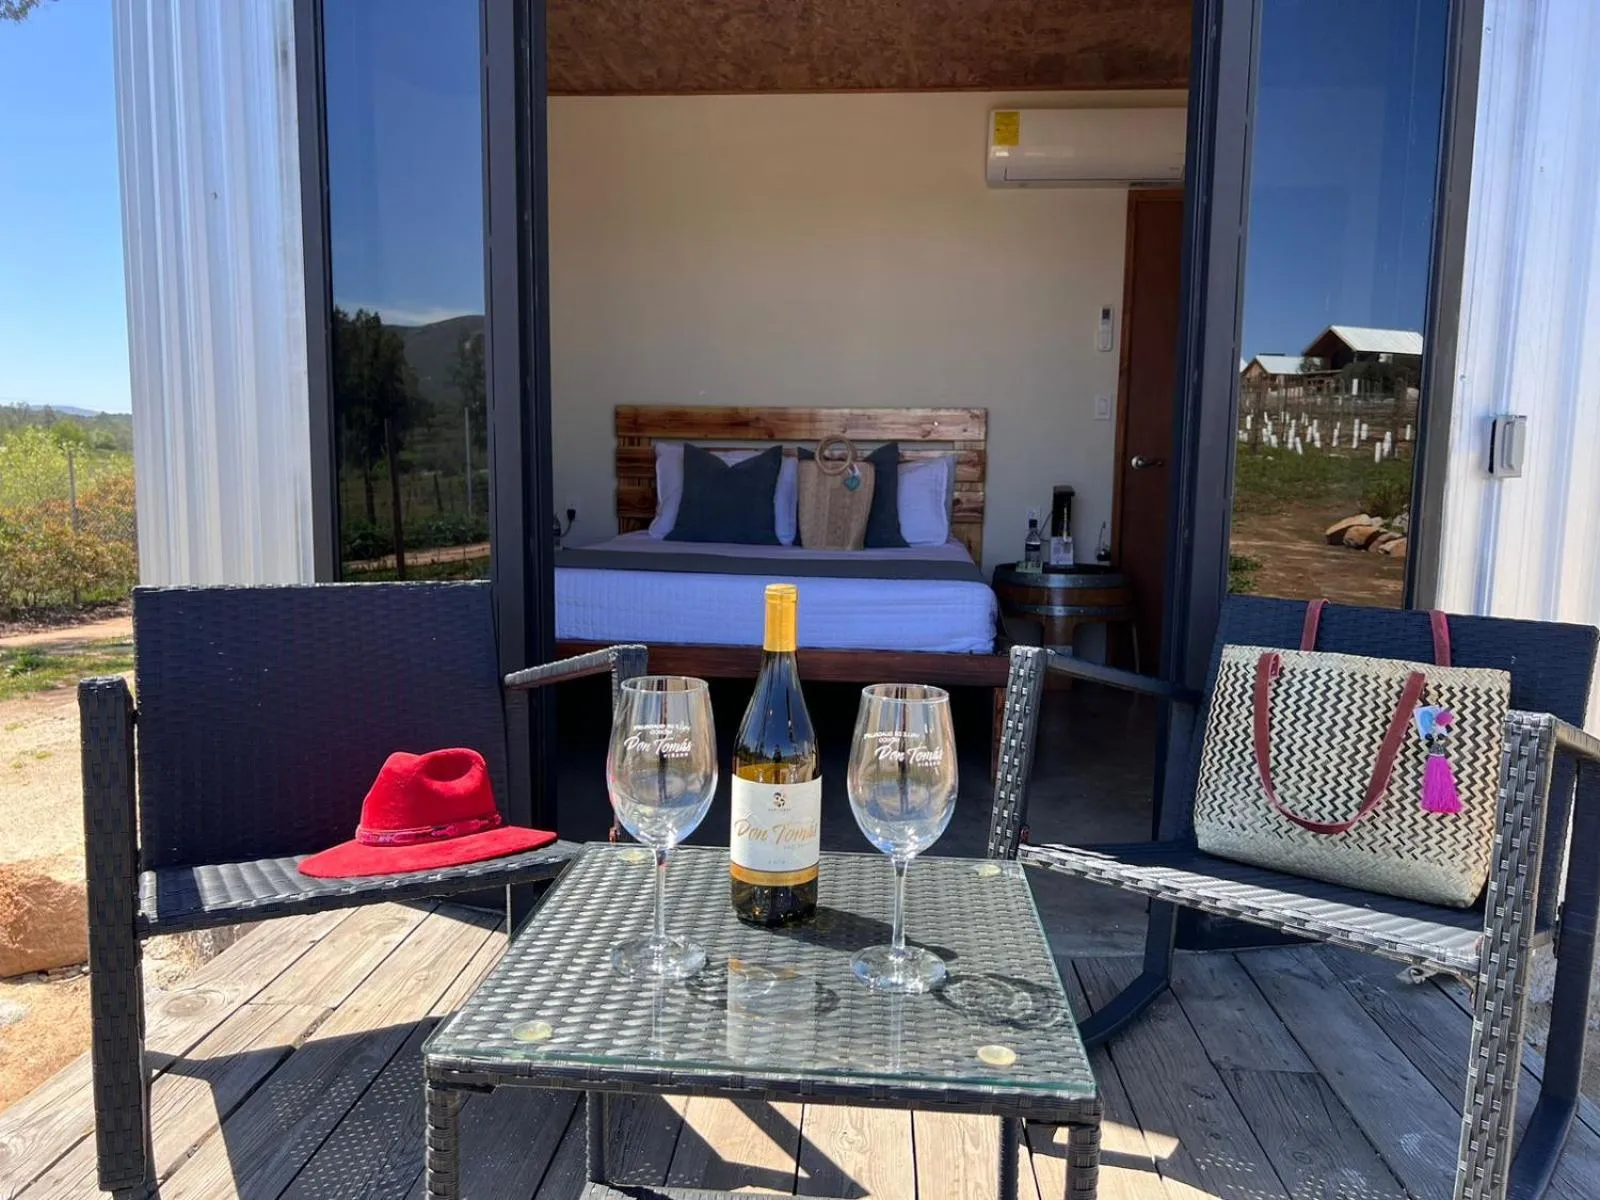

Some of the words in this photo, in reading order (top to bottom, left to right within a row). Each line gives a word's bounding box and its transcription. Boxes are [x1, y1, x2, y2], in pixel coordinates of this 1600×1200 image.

[623, 731, 652, 753] Don
[653, 730, 692, 755] Tomás
[874, 739, 906, 762] Don
[733, 811, 769, 843] Don
